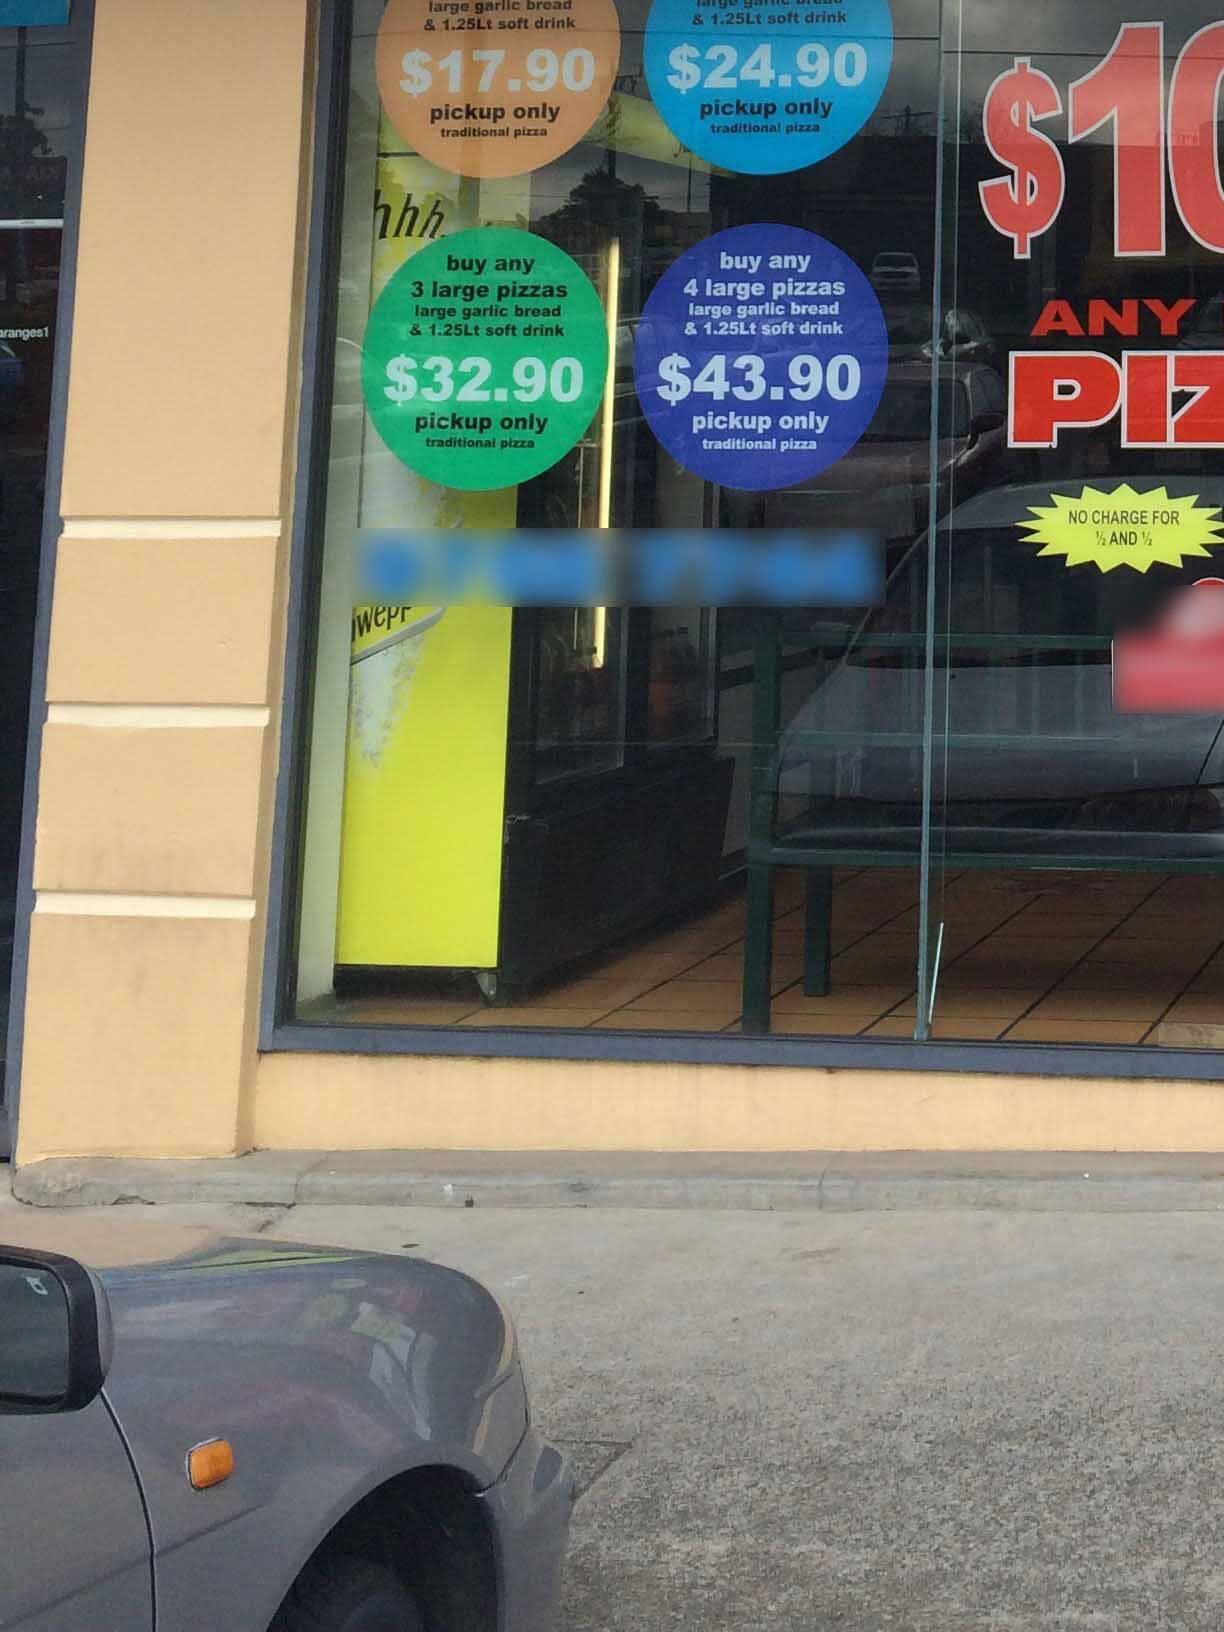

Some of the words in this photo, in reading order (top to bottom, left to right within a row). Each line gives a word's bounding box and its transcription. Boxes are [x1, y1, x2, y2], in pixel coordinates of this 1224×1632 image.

[428, 0, 470, 14] large
[424, 18, 436, 31] &
[442, 17, 493, 30] 1.25Lt
[497, 16, 529, 30] soft
[533, 16, 576, 29] drink
[692, 13, 705, 25] &
[710, 12, 762, 25] 1.25Lt
[767, 11, 800, 24] soft
[804, 11, 847, 23] drink
[399, 48, 595, 97] $17.90
[667, 41, 868, 94] $24.90
[430, 102, 505, 124] pickup
[512, 102, 560, 123] only
[699, 98, 776, 119] pickup
[785, 98, 833, 118] only
[440, 125, 509, 138] traditional
[513, 126, 548, 139] pizza
[710, 121, 781, 134] traditional
[785, 122, 820, 134] pizza
[446, 254, 485, 274] buy
[494, 256, 535, 275] any
[720, 251, 761, 273] buy
[769, 252, 811, 272] any
[411, 282, 425, 298] 3
[431, 281, 490, 301] large
[497, 282, 568, 301] pizzas
[683, 280, 698, 296] 4
[705, 279, 766, 299] large
[772, 280, 845, 299] pizzas
[415, 304, 457, 320] large
[462, 304, 509, 319] garlic
[514, 304, 562, 318] bread
[688, 303, 732, 318] large
[737, 303, 785, 318] garlic
[790, 302, 840, 315] bread
[1030, 299, 1195, 337] ANY
[409, 325, 422, 337] &
[428, 324, 480, 337] 1.25Lt
[485, 324, 518, 337] soft
[523, 324, 564, 337] drink
[684, 323, 698, 335] &
[703, 322, 756, 335] 1.25Lt
[762, 322, 795, 335] soft
[800, 322, 843, 335] drink
[383, 354, 584, 406] $32.90
[657, 353, 862, 406] $43.90
[415, 413, 492, 433] pickup
[500, 413, 548, 434] only
[692, 412, 771, 433] pickup
[780, 412, 829, 432] only
[425, 437, 496, 449] traditional
[500, 438, 535, 450] pizza
[702, 437, 776, 450] traditional
[780, 438, 817, 452] pizza
[1068, 511, 1088, 524] NO
[1091, 510, 1151, 525] CHARGE
[1154, 510, 1179, 524] FOR
[1110, 532, 1138, 546] AND
